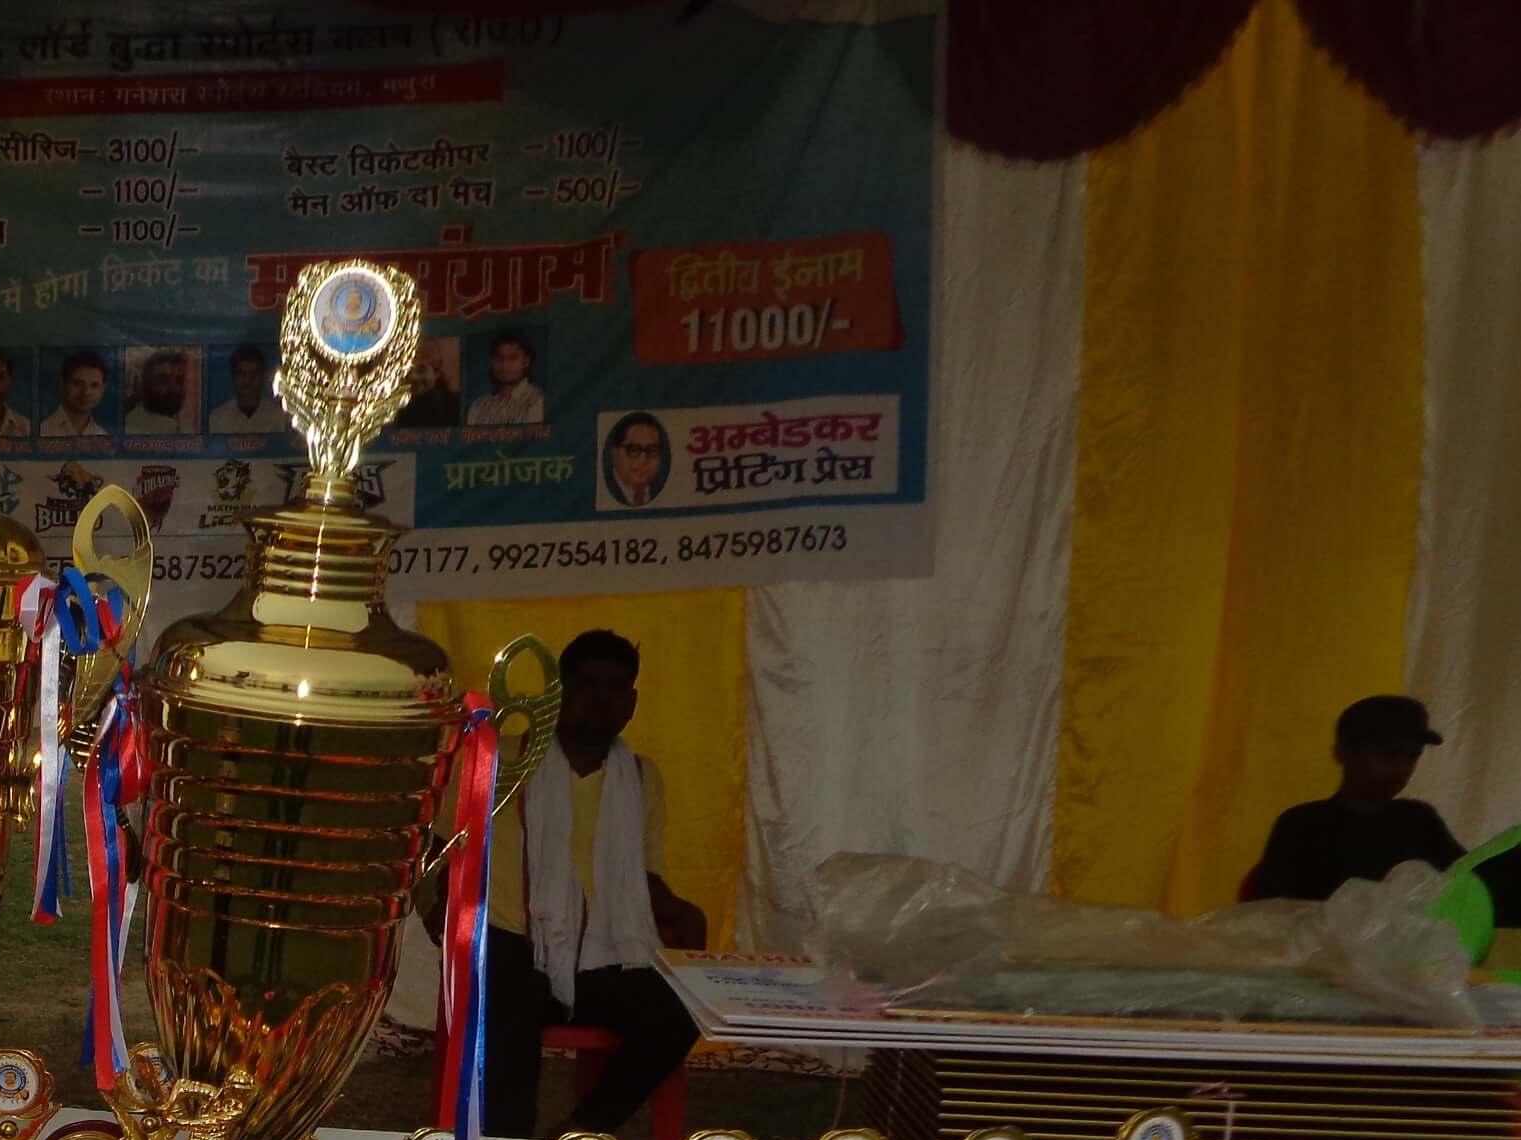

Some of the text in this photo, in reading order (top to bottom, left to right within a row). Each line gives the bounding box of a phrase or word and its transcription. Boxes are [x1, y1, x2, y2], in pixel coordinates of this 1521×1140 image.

[686, 410, 883, 455] अम्बेडकर
[444, 450, 576, 490] प्रायोजक
[812, 446, 876, 486] प्रेस
[679, 525, 848, 563] 8475987673
